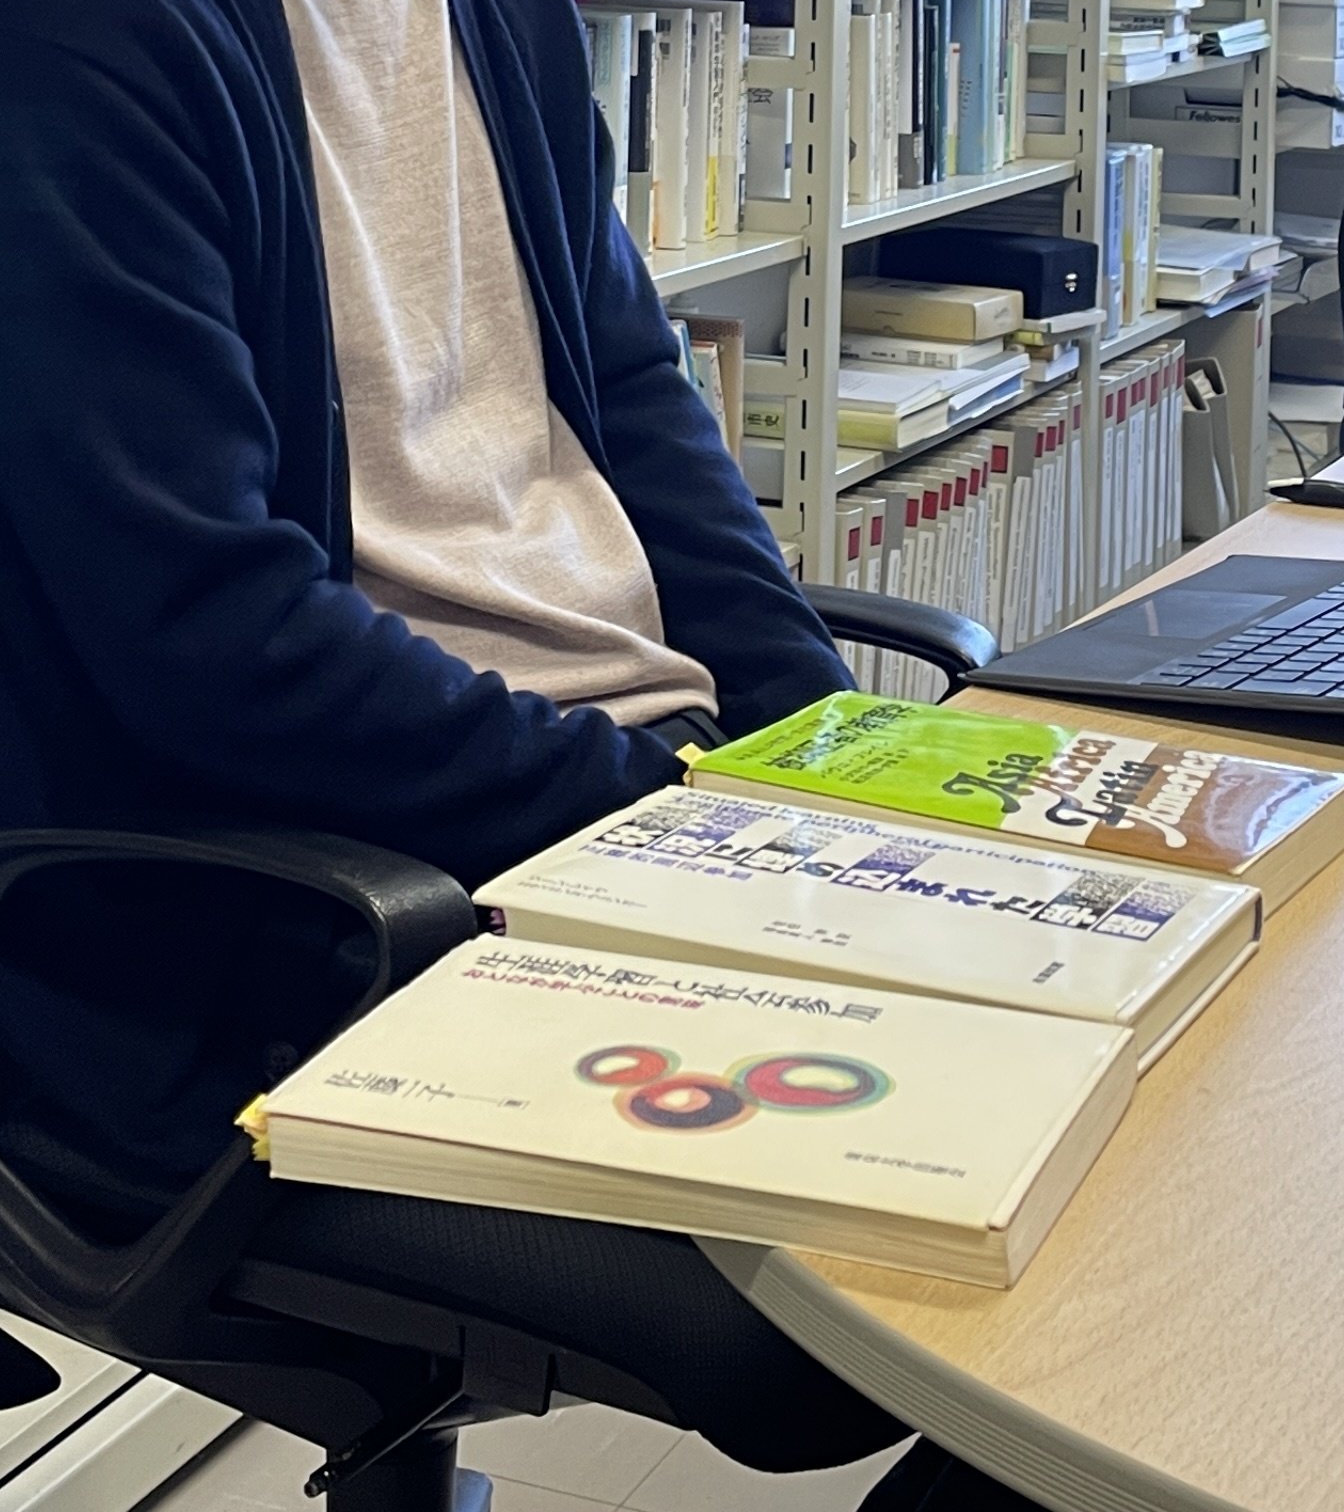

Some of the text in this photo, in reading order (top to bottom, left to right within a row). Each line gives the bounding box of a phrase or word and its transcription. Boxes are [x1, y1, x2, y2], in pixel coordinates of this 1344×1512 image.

[941, 750, 1045, 814] Asia
[1045, 758, 1159, 829] Latin
[1112, 748, 1226, 848] America
[592, 813, 1166, 943] 状況に埋め込まれた学習
[475, 949, 885, 1025] 生涯学習と社会参加
